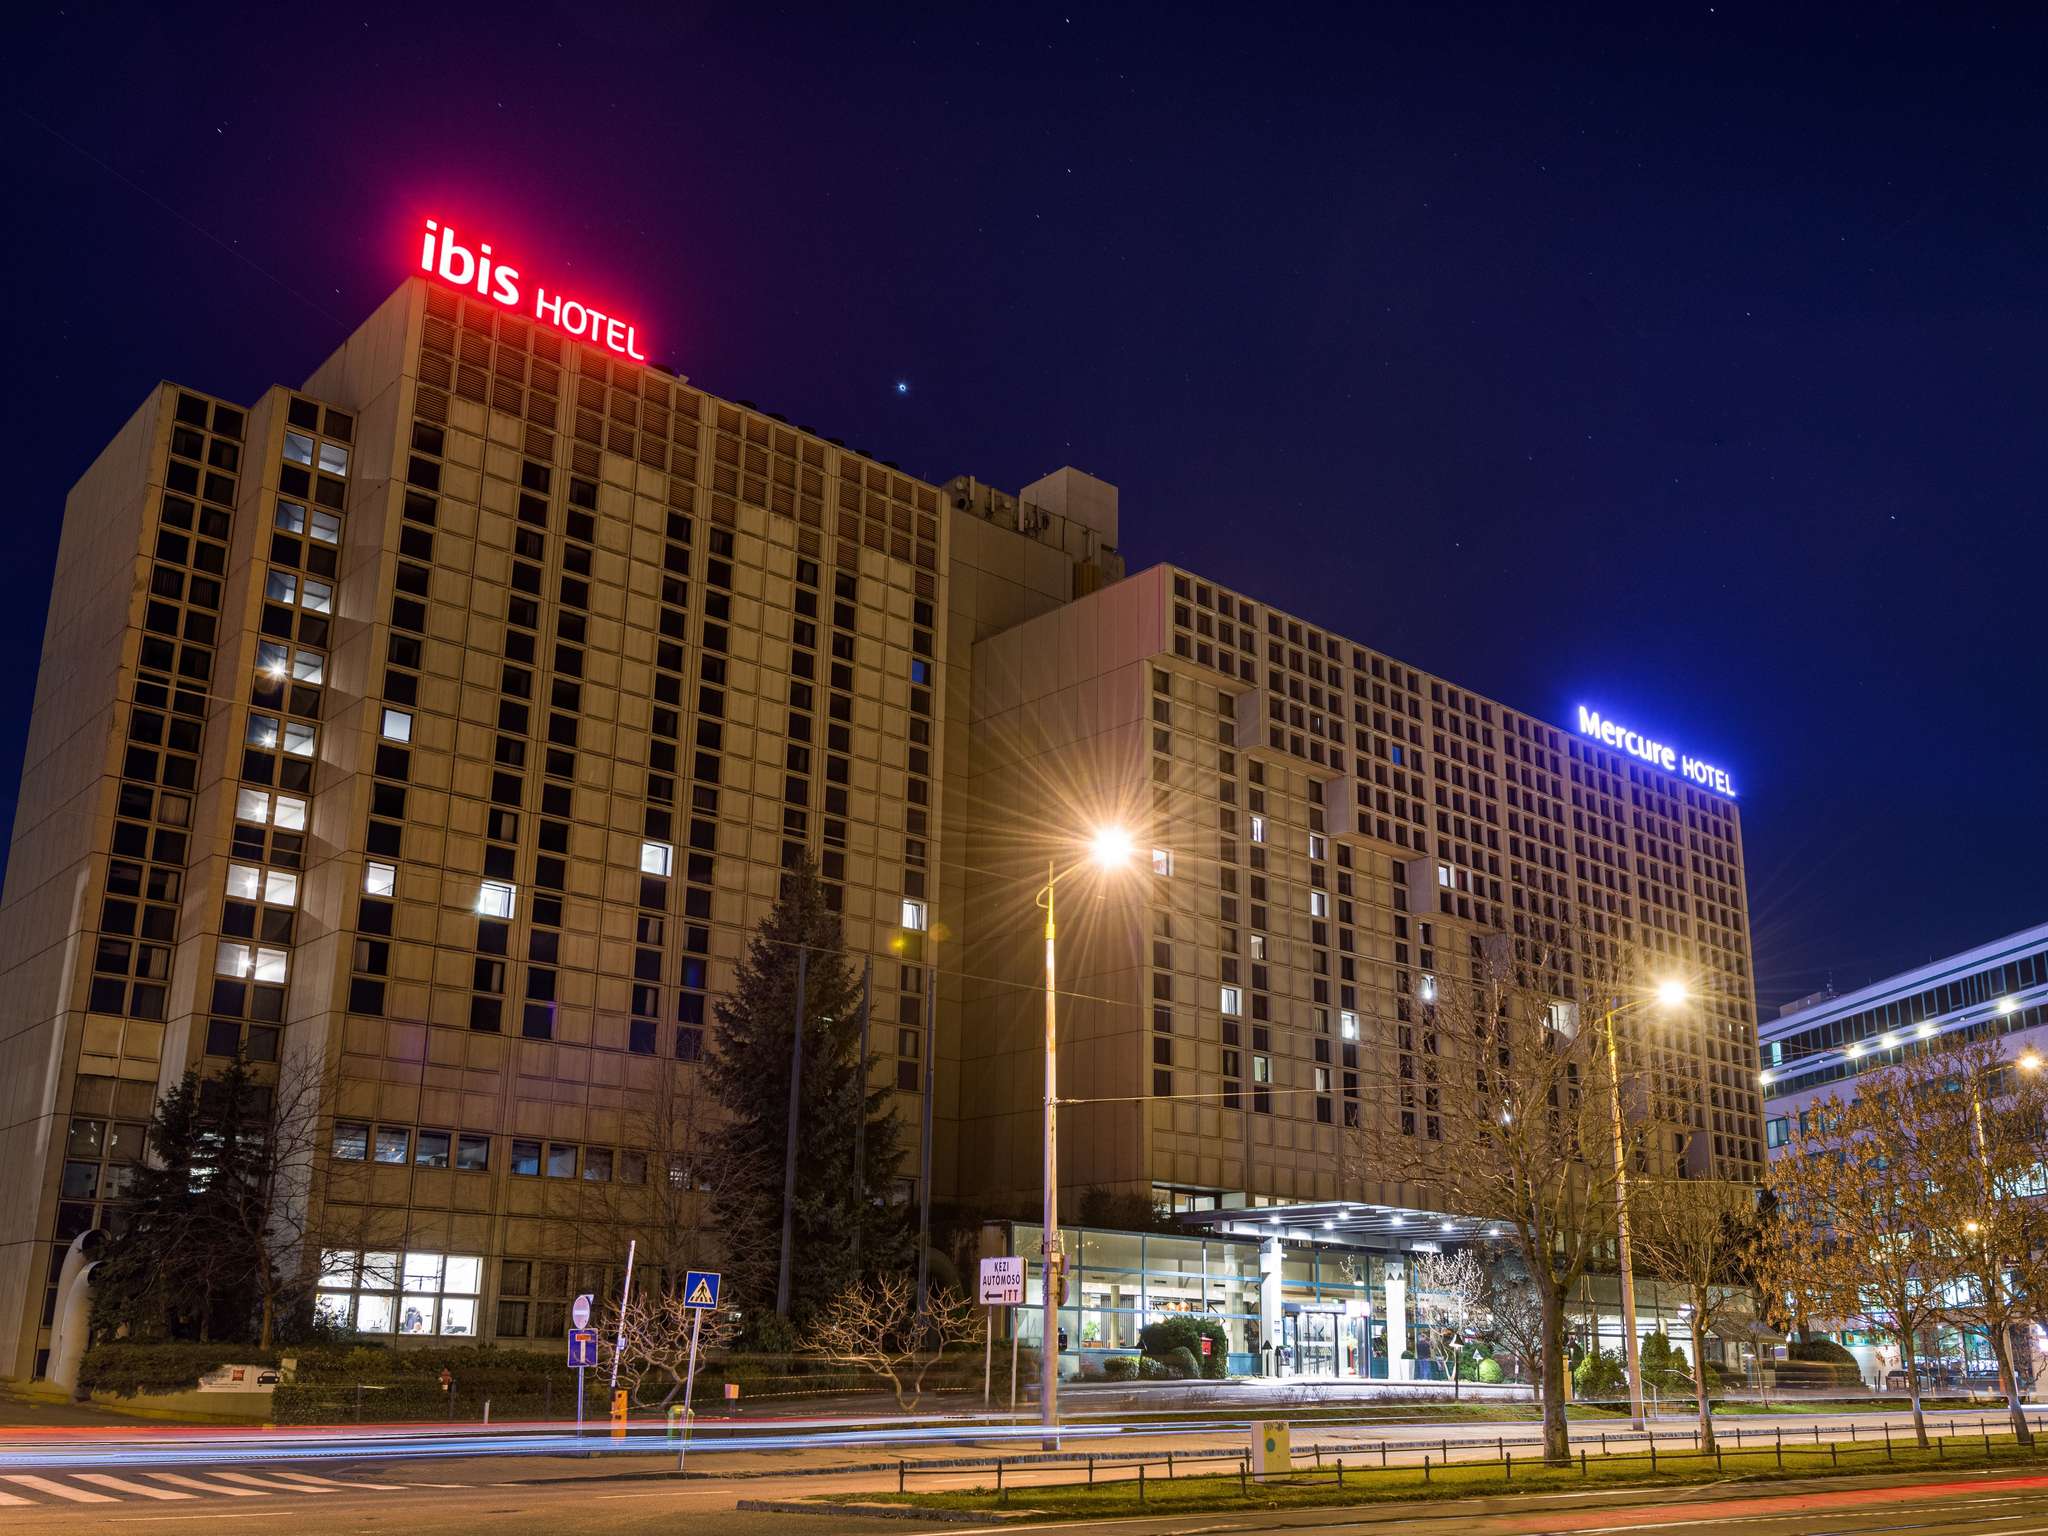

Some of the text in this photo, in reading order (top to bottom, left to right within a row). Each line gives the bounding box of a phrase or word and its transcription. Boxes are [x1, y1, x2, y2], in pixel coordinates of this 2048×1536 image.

[422, 219, 644, 360] ibis HOTEL
[1579, 705, 1736, 797] Mercure HOTEL
[1003, 1289, 1019, 1301] ITT
